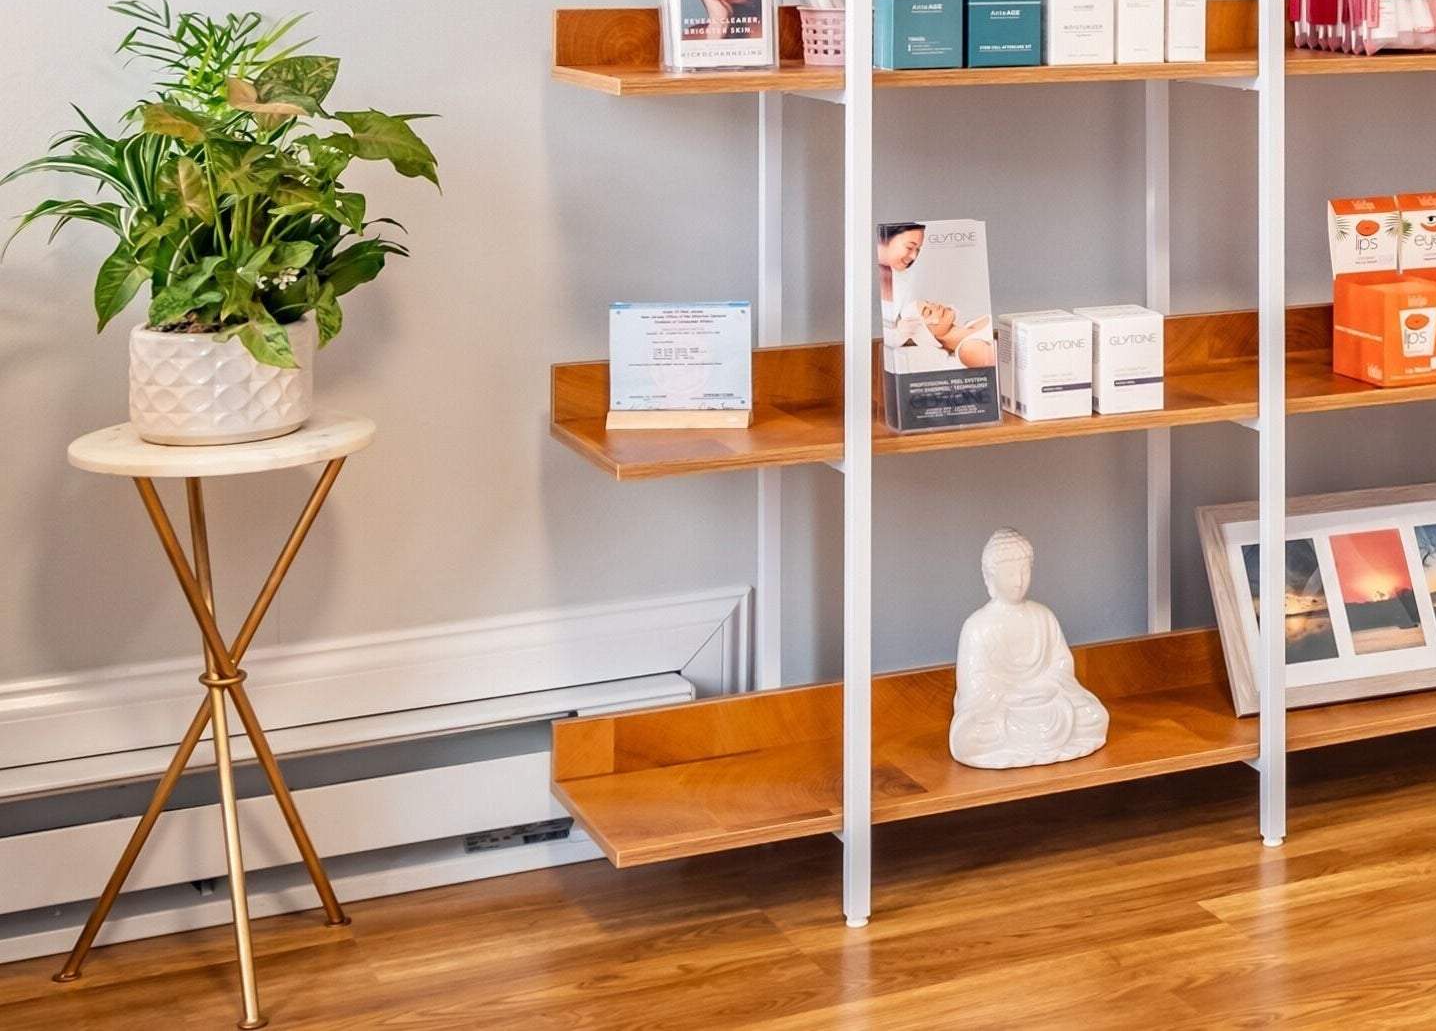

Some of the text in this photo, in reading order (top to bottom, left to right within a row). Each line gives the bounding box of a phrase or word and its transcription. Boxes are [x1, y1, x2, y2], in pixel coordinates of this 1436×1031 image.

[928, 231, 976, 245] GLYTONE
[1355, 236, 1378, 255] lips
[1037, 338, 1085, 353] GLYTONE
[1109, 332, 1157, 346] GLYTONE
